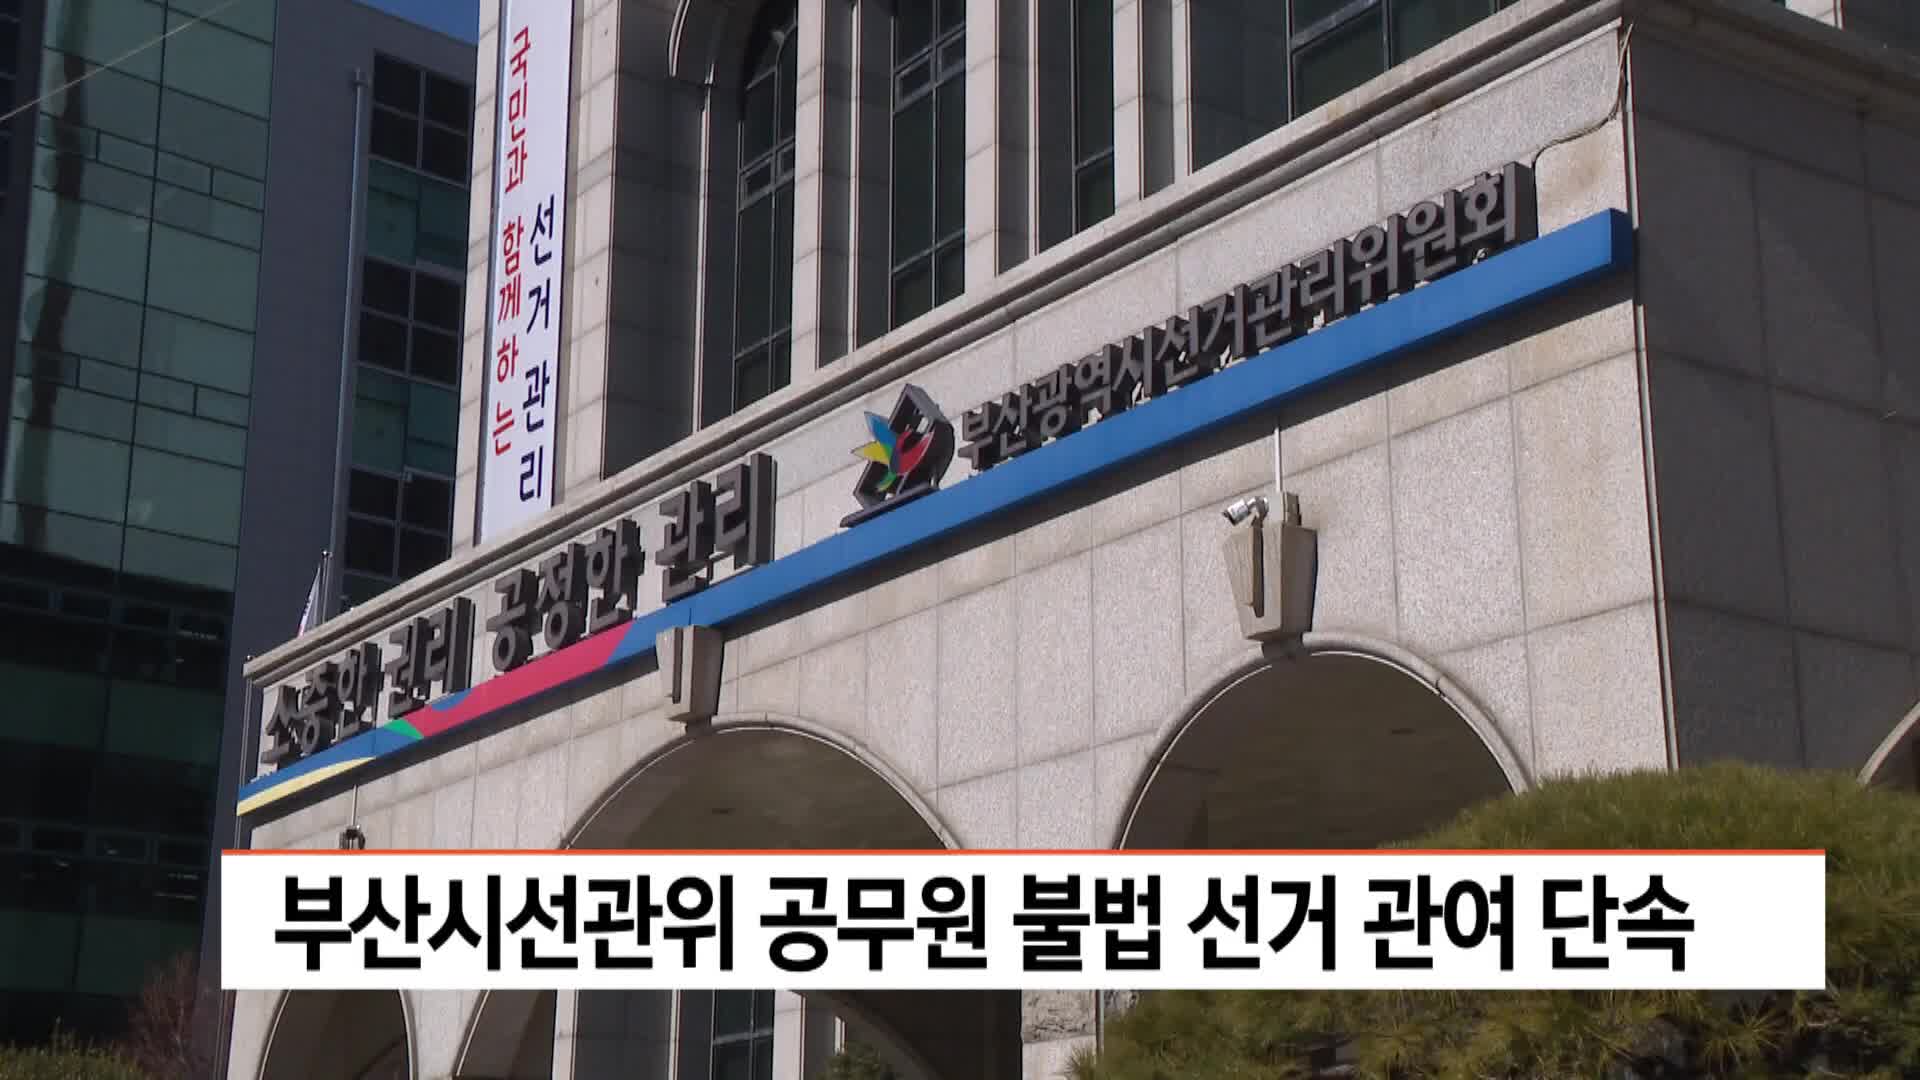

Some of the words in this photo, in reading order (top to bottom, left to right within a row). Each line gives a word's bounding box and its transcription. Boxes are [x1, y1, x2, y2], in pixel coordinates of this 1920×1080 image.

[506, 25, 531, 193] 국민과
[492, 217, 524, 457] 함께하는
[959, 162, 1533, 473] 부산광역시선거관리위원회
[261, 643, 382, 765] 소중한
[386, 597, 475, 718] 권리
[486, 518, 645, 674] 공정한
[656, 453, 776, 604] 관리
